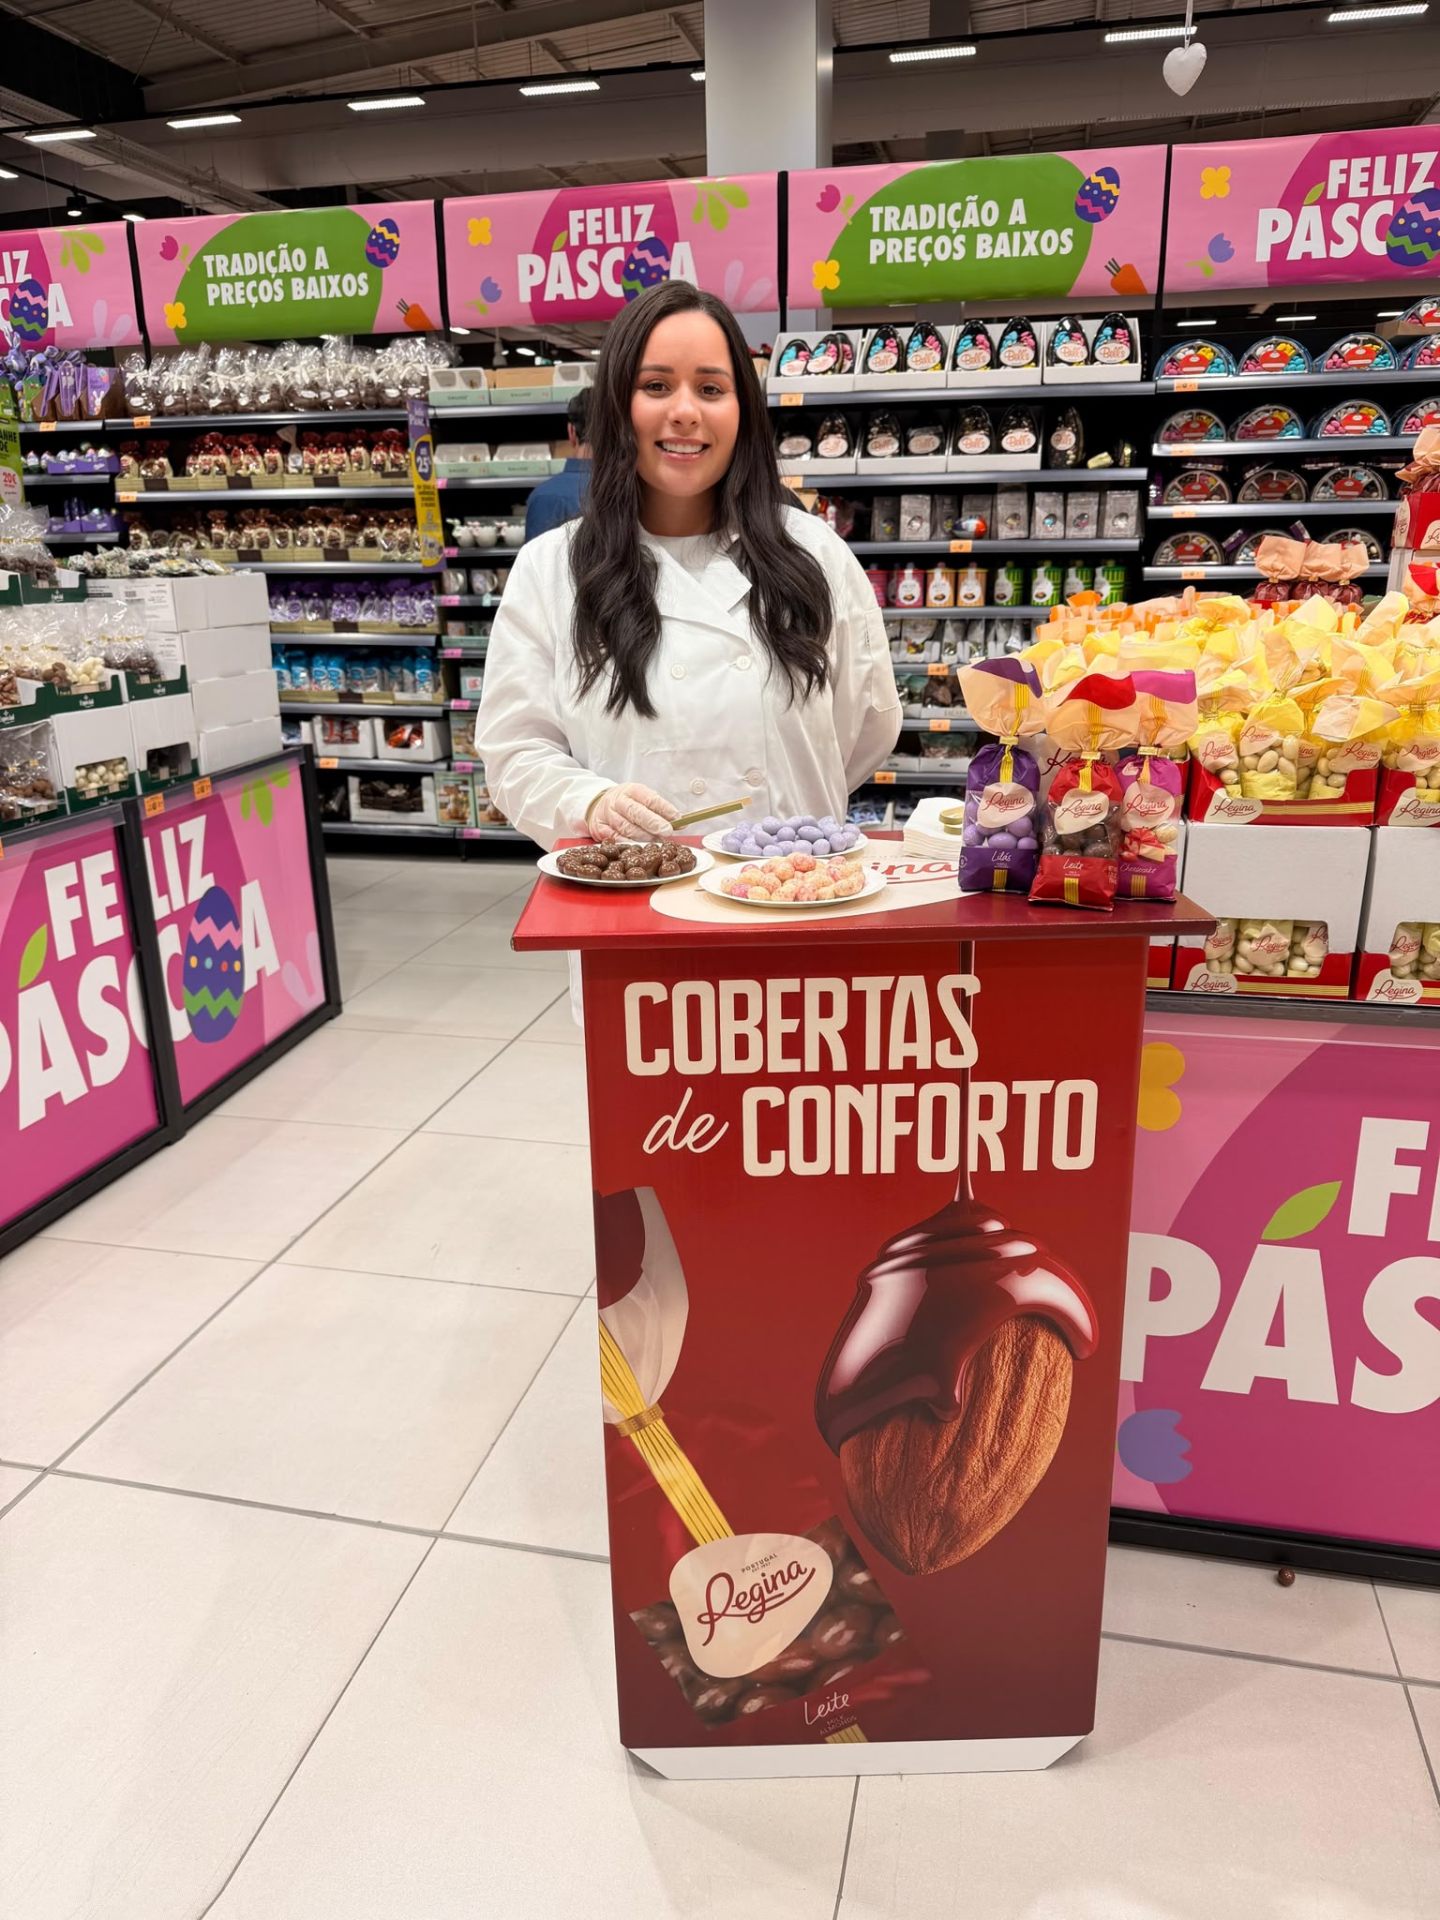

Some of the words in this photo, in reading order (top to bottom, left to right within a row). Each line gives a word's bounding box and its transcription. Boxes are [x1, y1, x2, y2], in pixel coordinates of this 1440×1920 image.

[1326, 151, 1439, 199] FELIZ
[569, 204, 656, 246] FELIZ
[869, 195, 1000, 234] TRADIÇÃO
[1008, 198, 1027, 225] A
[203, 243, 307, 278] TRADIÇÃO
[314, 246, 329, 270] A
[869, 234, 966, 268] PREÇOS
[976, 228, 1074, 259] BAIXOS
[206, 279, 284, 308] PREÇOS
[291, 272, 369, 301] BAIXOS
[1340, 741, 1379, 761] Regina
[982, 792, 1030, 812] Regina
[1057, 799, 1104, 819] Regina
[1123, 794, 1169, 816] Regina
[1210, 798, 1257, 817] Regina
[1191, 973, 1232, 993] Regina
[1371, 979, 1418, 1001] Regina
[624, 973, 981, 1077] COBERTAS
[642, 1086, 729, 1155] de
[742, 1079, 1099, 1177] CONFORTO
[741, 1553, 778, 1573] PORTUGAL
[697, 1560, 816, 1646] Regina
[804, 1692, 850, 1726] Leite
